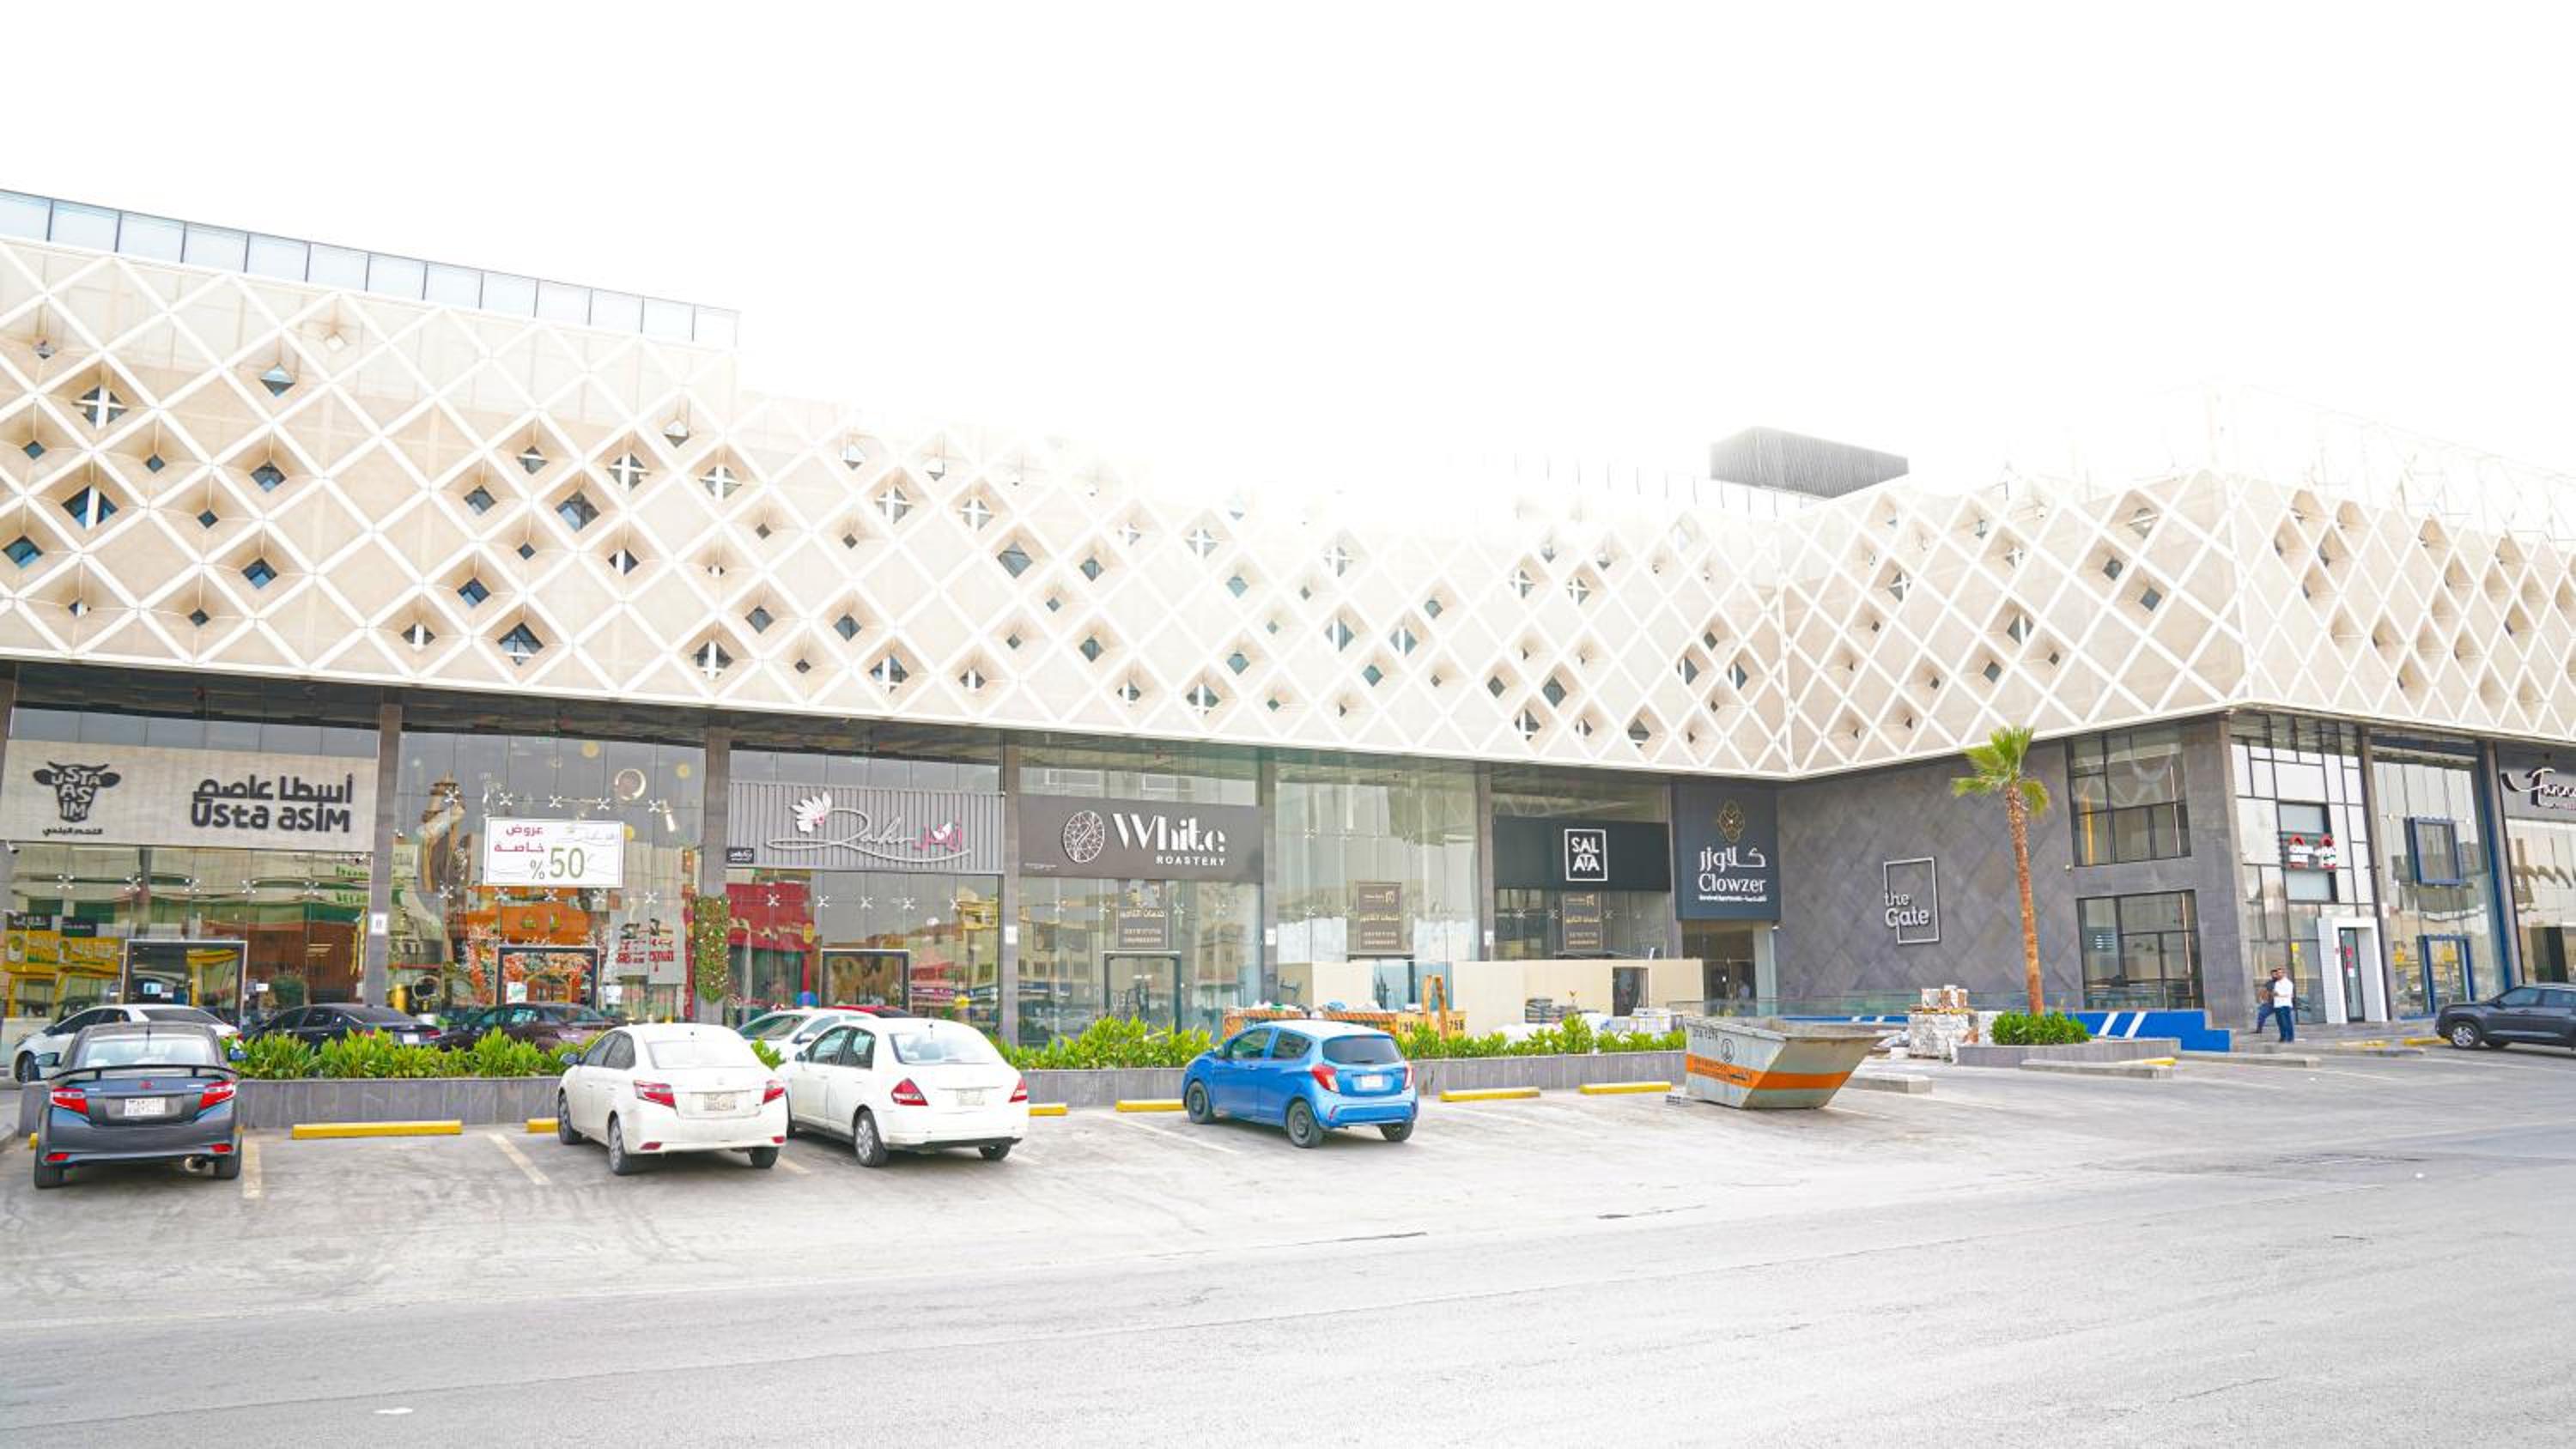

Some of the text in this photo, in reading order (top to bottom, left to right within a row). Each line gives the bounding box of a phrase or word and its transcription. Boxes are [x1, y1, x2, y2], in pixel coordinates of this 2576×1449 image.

[59, 783, 93, 803] AS
[192, 774, 274, 803] عاصم
[191, 800, 270, 830] Usta
[506, 824, 544, 837] عروض
[1112, 813, 1226, 853] White
[494, 841, 544, 852] خاصة
[1571, 836, 1600, 853] SAL
[1156, 855, 1226, 867] ROASTERY
[1572, 853, 1601, 871] ATA
[1700, 846, 1766, 872] كلاوزر
[1698, 873, 1767, 893] Clowzer
[1884, 890, 1910, 906] the
[1885, 906, 1930, 928] Gate
